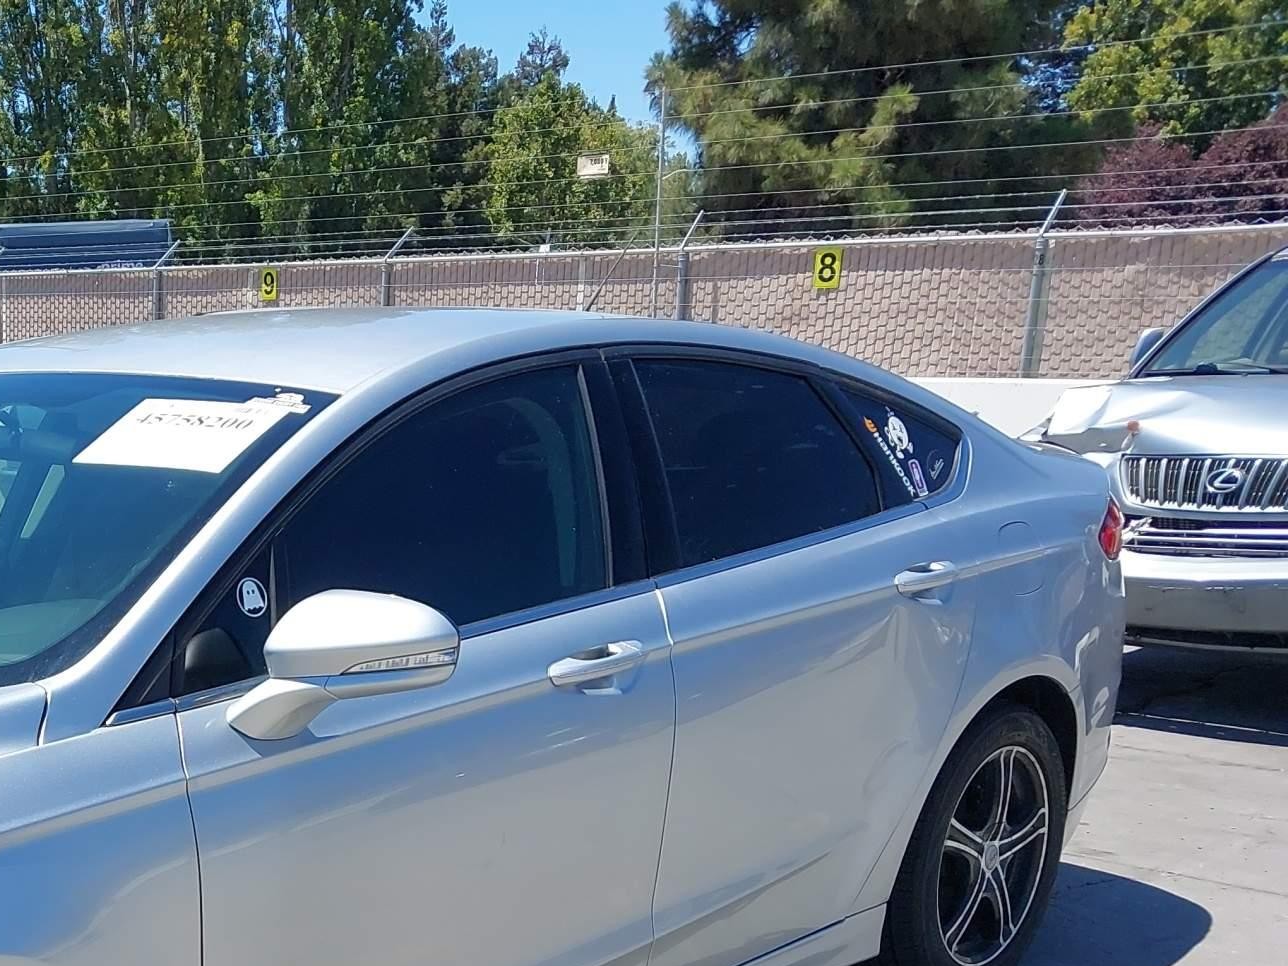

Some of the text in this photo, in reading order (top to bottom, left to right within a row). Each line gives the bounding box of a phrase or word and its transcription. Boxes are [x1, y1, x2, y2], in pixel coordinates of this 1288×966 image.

[818, 252, 837, 283] 8
[263, 271, 275, 296] 9
[136, 412, 254, 430] 45758200
